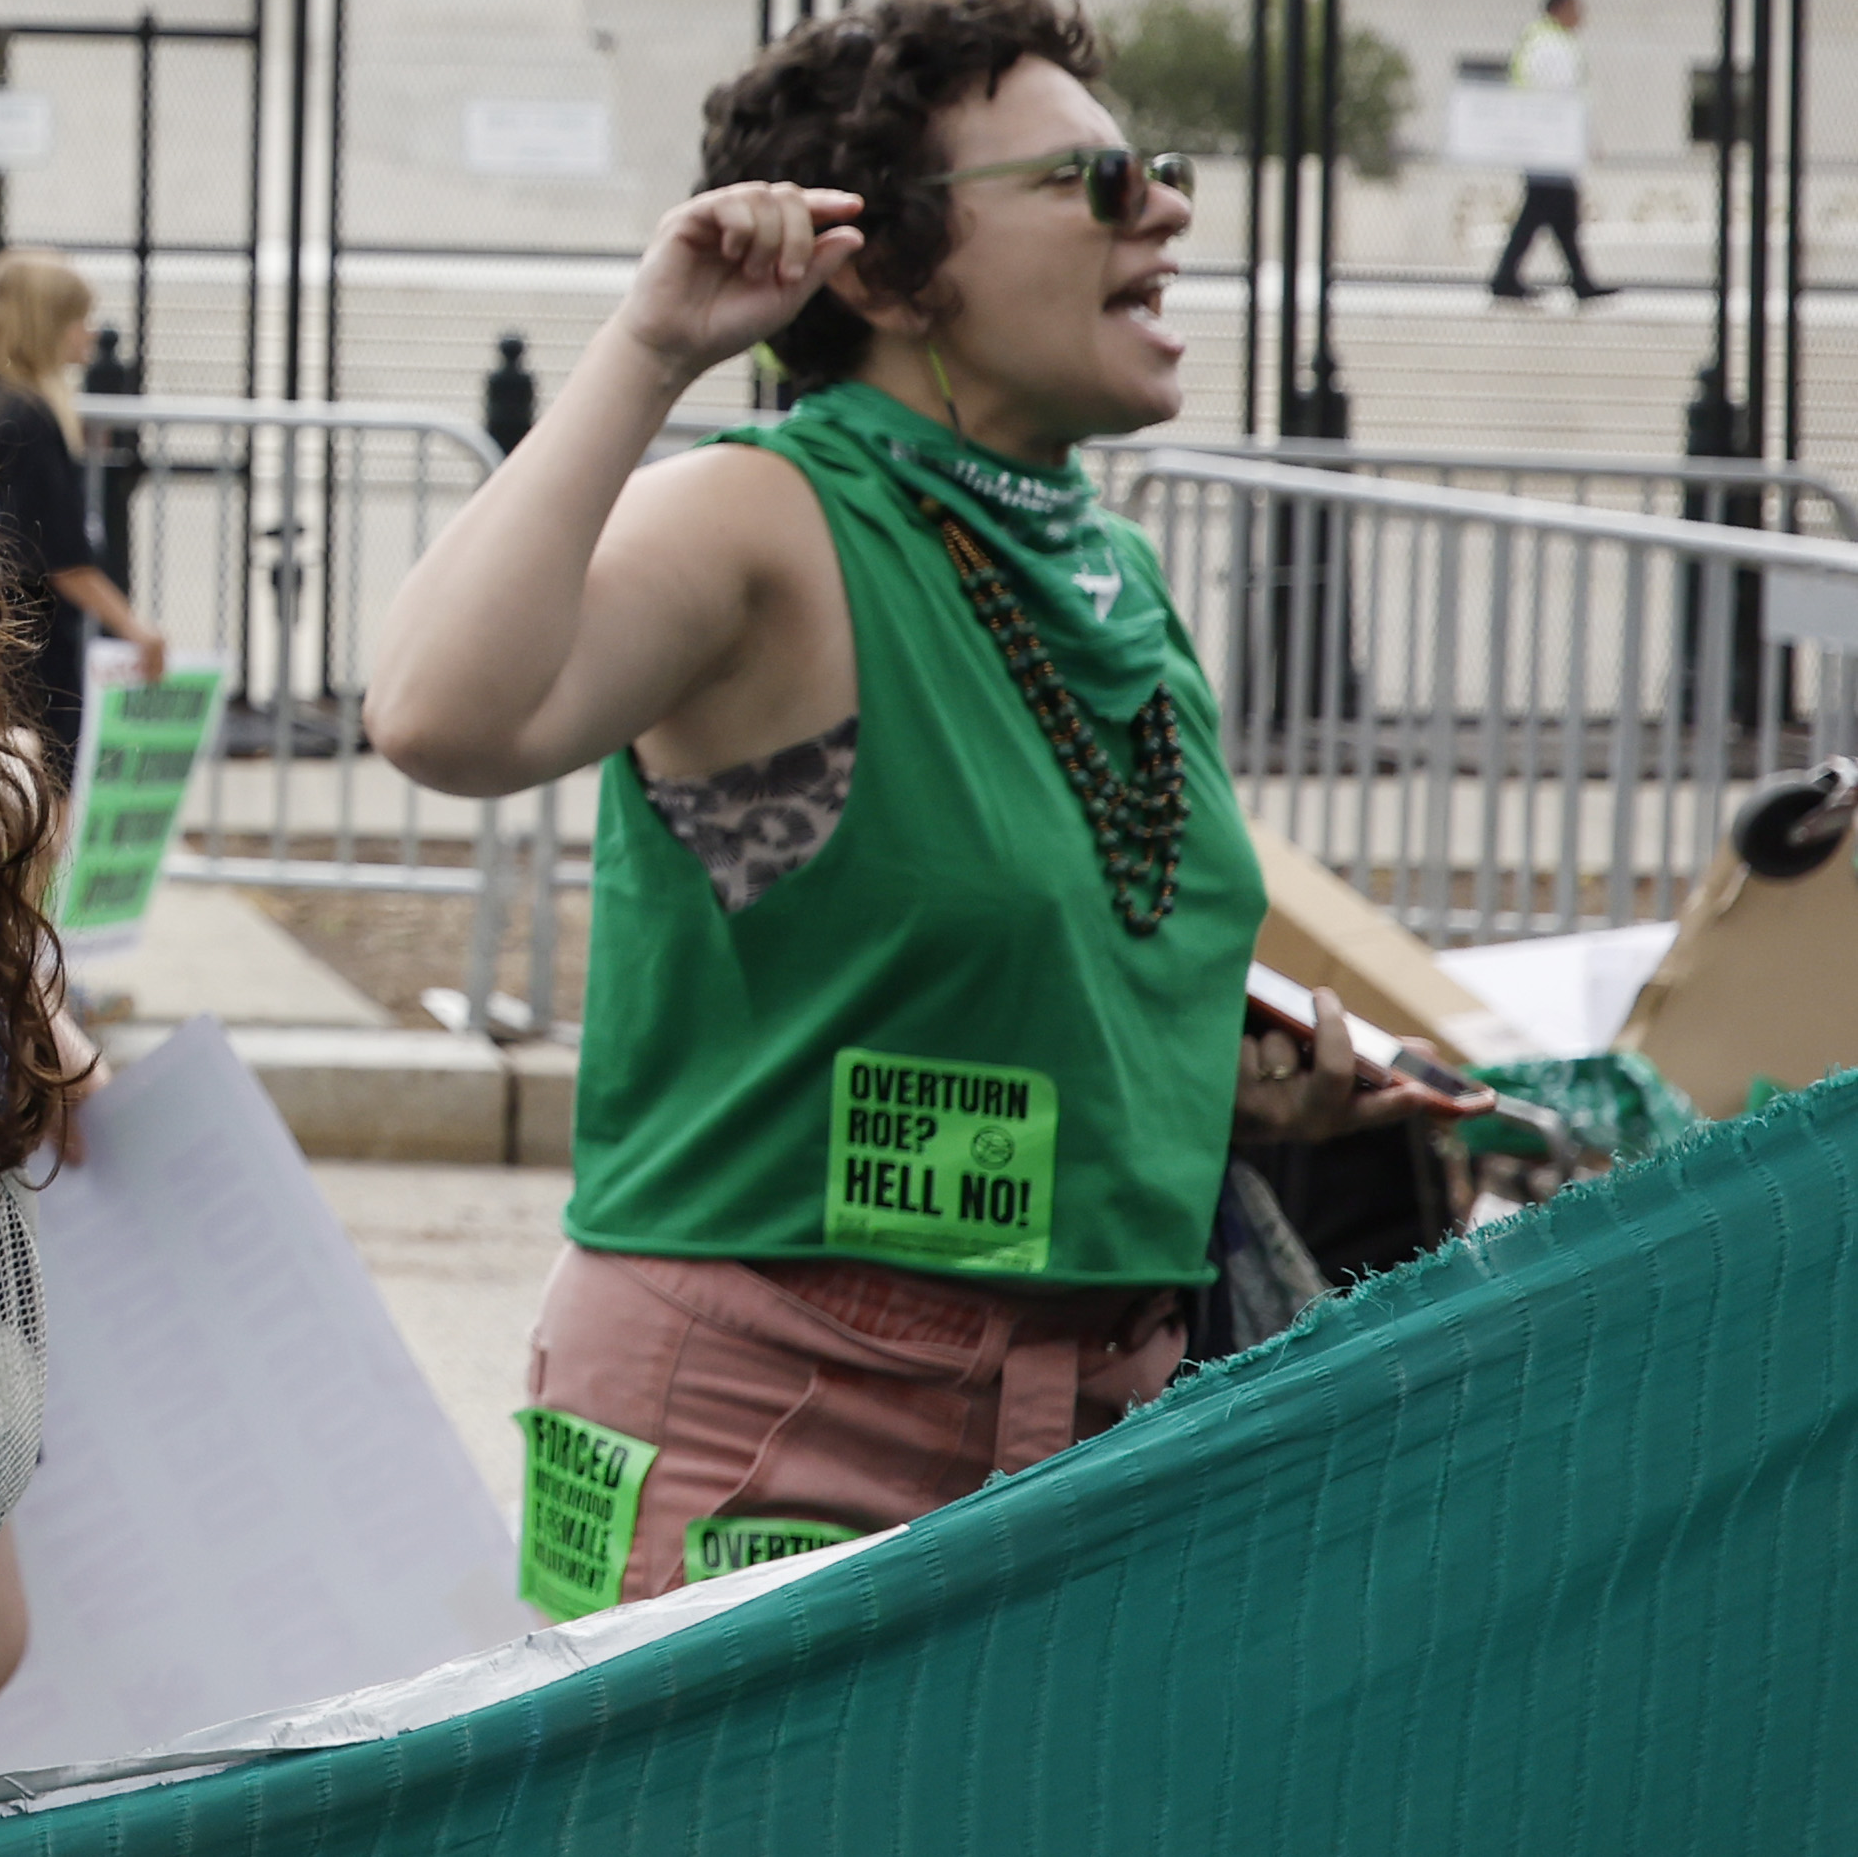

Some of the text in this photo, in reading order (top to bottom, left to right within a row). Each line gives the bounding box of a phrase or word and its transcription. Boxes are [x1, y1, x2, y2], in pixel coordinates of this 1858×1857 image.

[849, 1062, 1029, 1120] OVERTURN
[847, 1107, 938, 1155] ROE?
[845, 1156, 1031, 1227] HELL NO!
